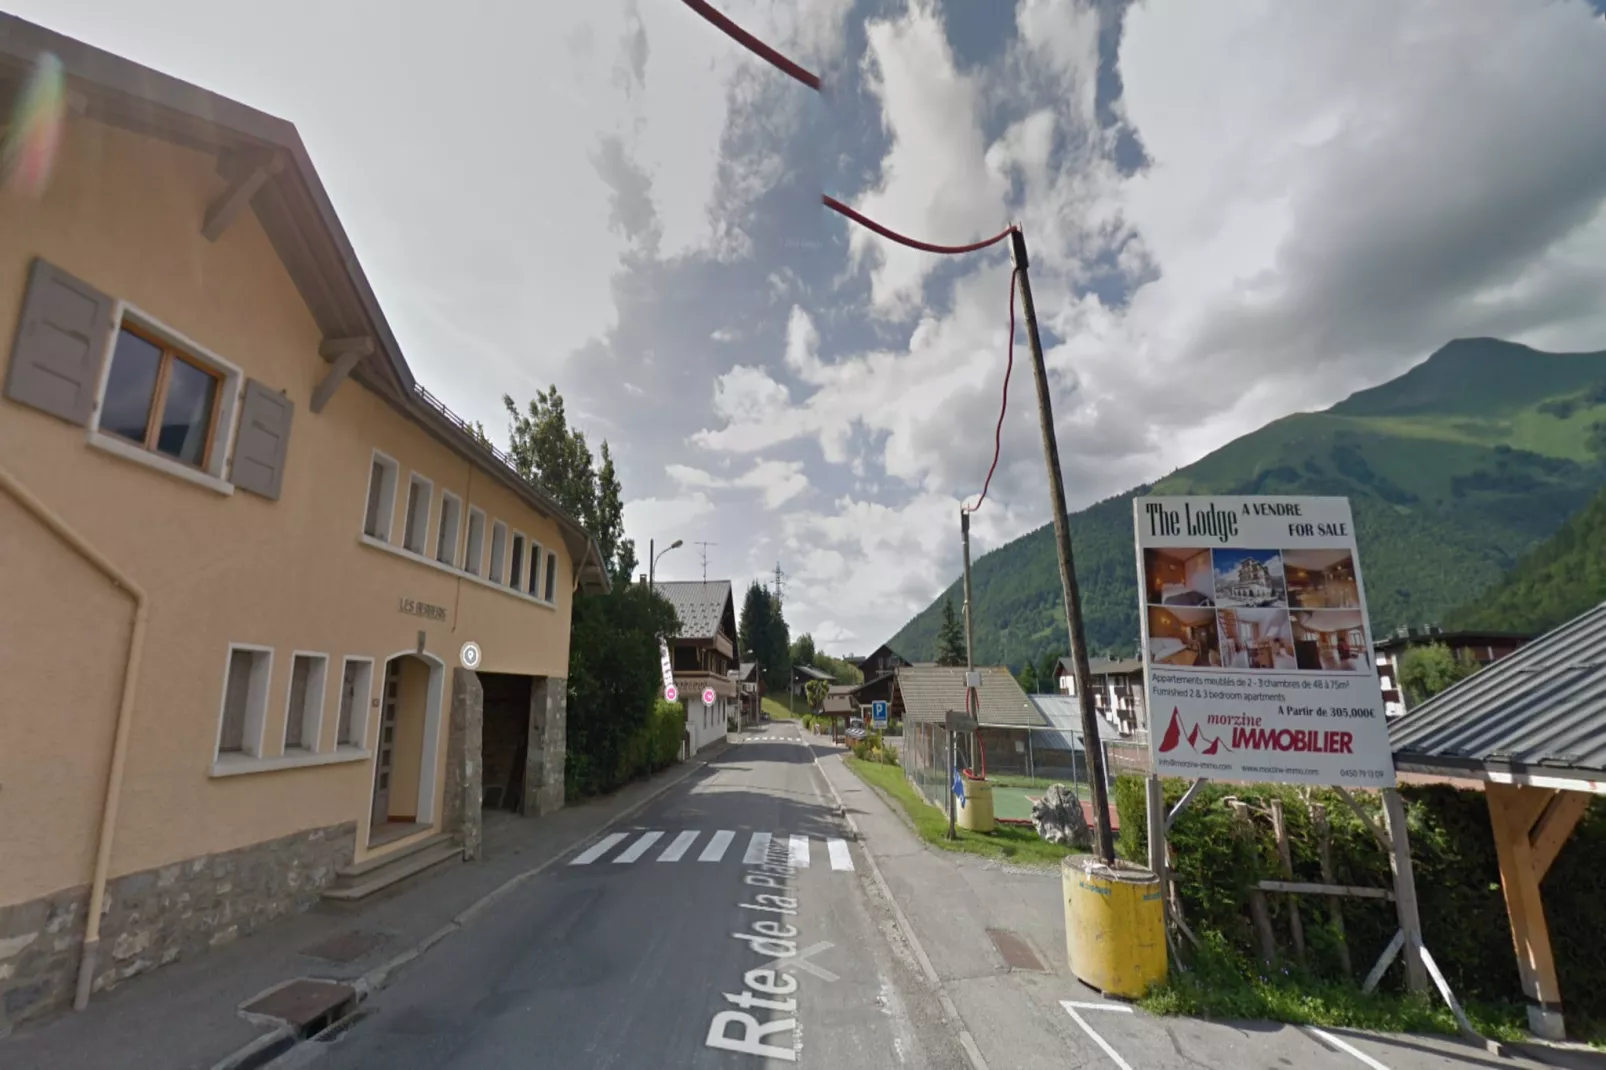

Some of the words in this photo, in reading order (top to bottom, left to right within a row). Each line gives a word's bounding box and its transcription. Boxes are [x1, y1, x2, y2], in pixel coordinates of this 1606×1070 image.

[1242, 503, 1250, 516] A
[1253, 503, 1302, 517] VENDRE
[1146, 502, 1180, 536] The
[1185, 502, 1239, 543] Lodge
[1288, 523, 1315, 537] FOR
[1317, 523, 1348, 537] SALE
[1152, 673, 1203, 685] Appartements
[1237, 678, 1245, 687] de
[1247, 679, 1252, 687] 2
[1258, 679, 1263, 688] 3
[1263, 679, 1300, 689] chambres
[1301, 680, 1311, 689] de
[1153, 686, 1188, 697] Furnished
[1189, 689, 1194, 697] 2
[1195, 689, 1202, 698] &
[1203, 689, 1209, 698] 3
[1209, 690, 1243, 700] bedroom
[1243, 691, 1286, 702] apartments
[1278, 705, 1284, 715] A
[1286, 706, 1314, 716] Partir
[1316, 707, 1328, 717] de
[1207, 712, 1262, 727] morzine
[1232, 728, 1354, 754] IMMOBILIER
